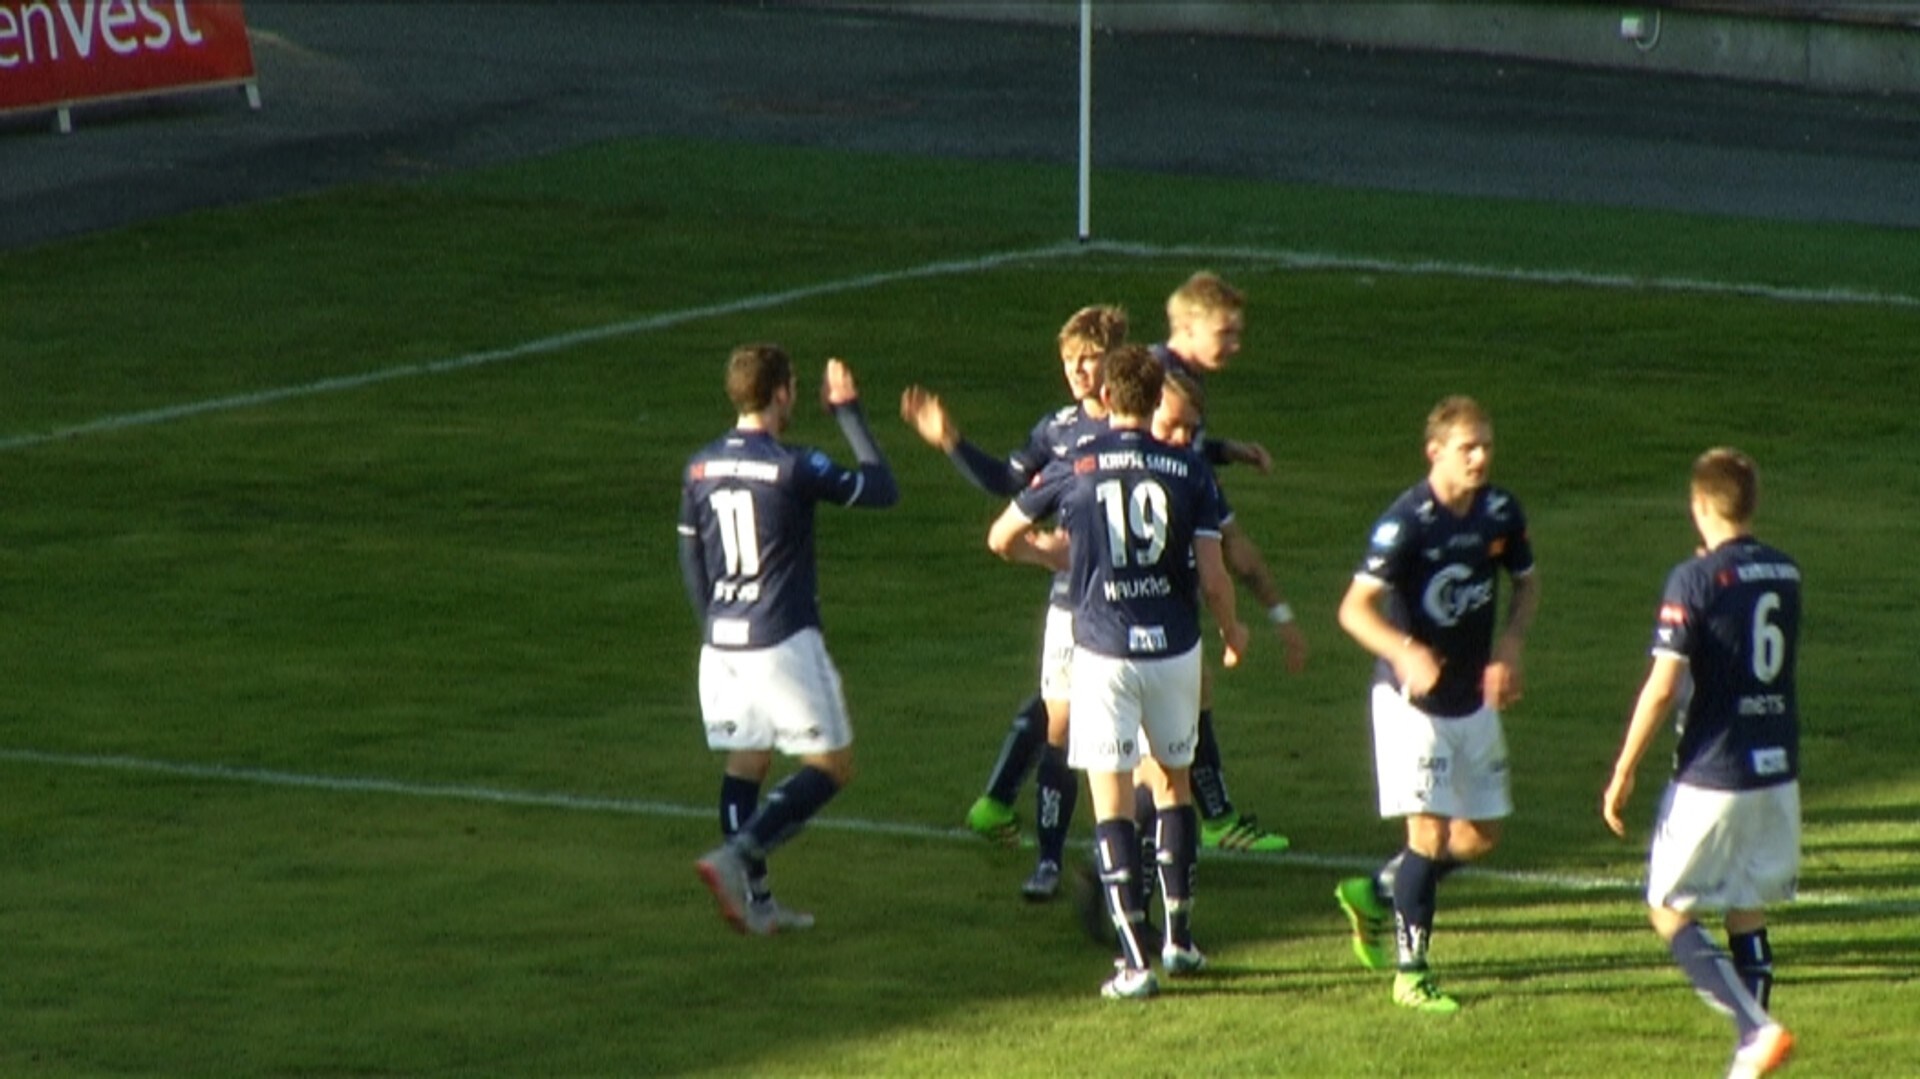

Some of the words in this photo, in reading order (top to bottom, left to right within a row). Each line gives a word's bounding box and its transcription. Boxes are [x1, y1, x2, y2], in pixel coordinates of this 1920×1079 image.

[709, 489, 759, 576] 11
[1096, 478, 1168, 569] 19
[1752, 592, 1785, 682] 6
